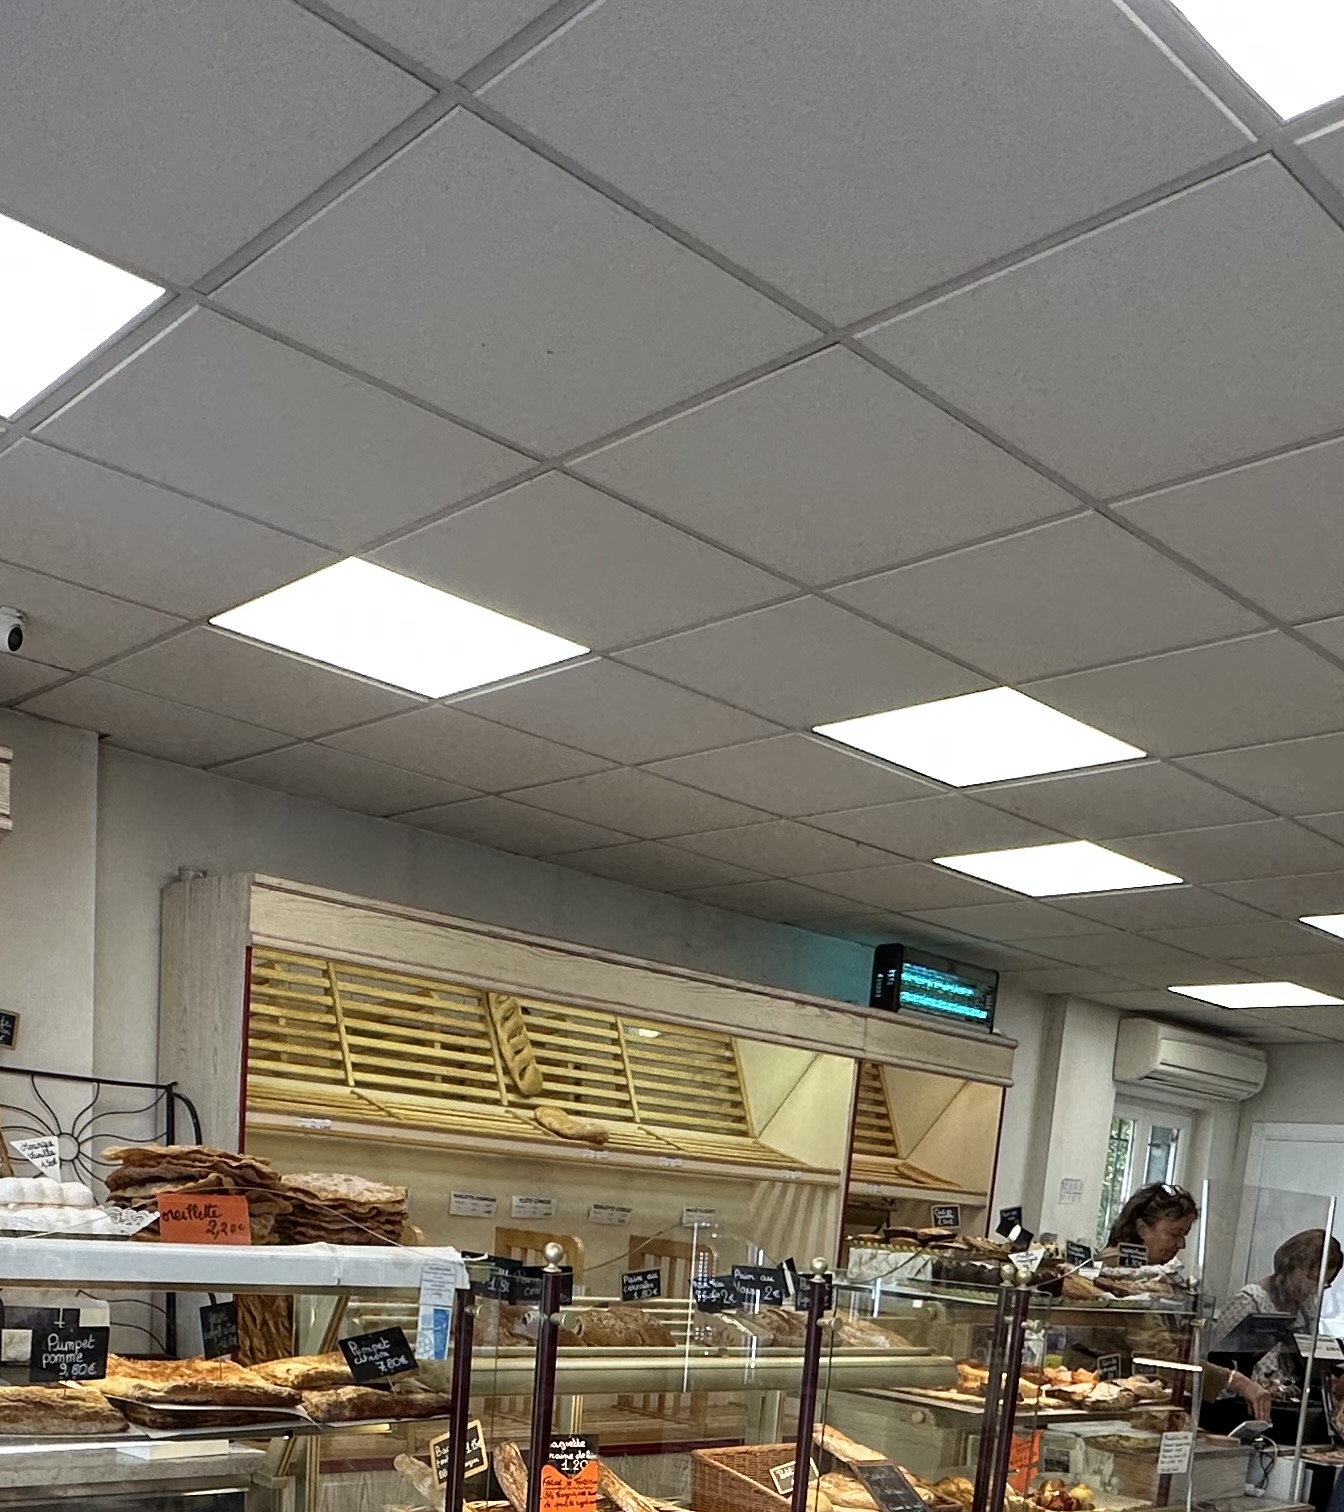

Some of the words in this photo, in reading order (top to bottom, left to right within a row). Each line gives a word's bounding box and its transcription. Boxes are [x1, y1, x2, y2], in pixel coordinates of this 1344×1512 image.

[734, 1268, 755, 1282] Pain
[47, 1333, 96, 1351] Pumpet
[42, 1352, 84, 1369] pomme
[549, 1437, 586, 1450] aguette
